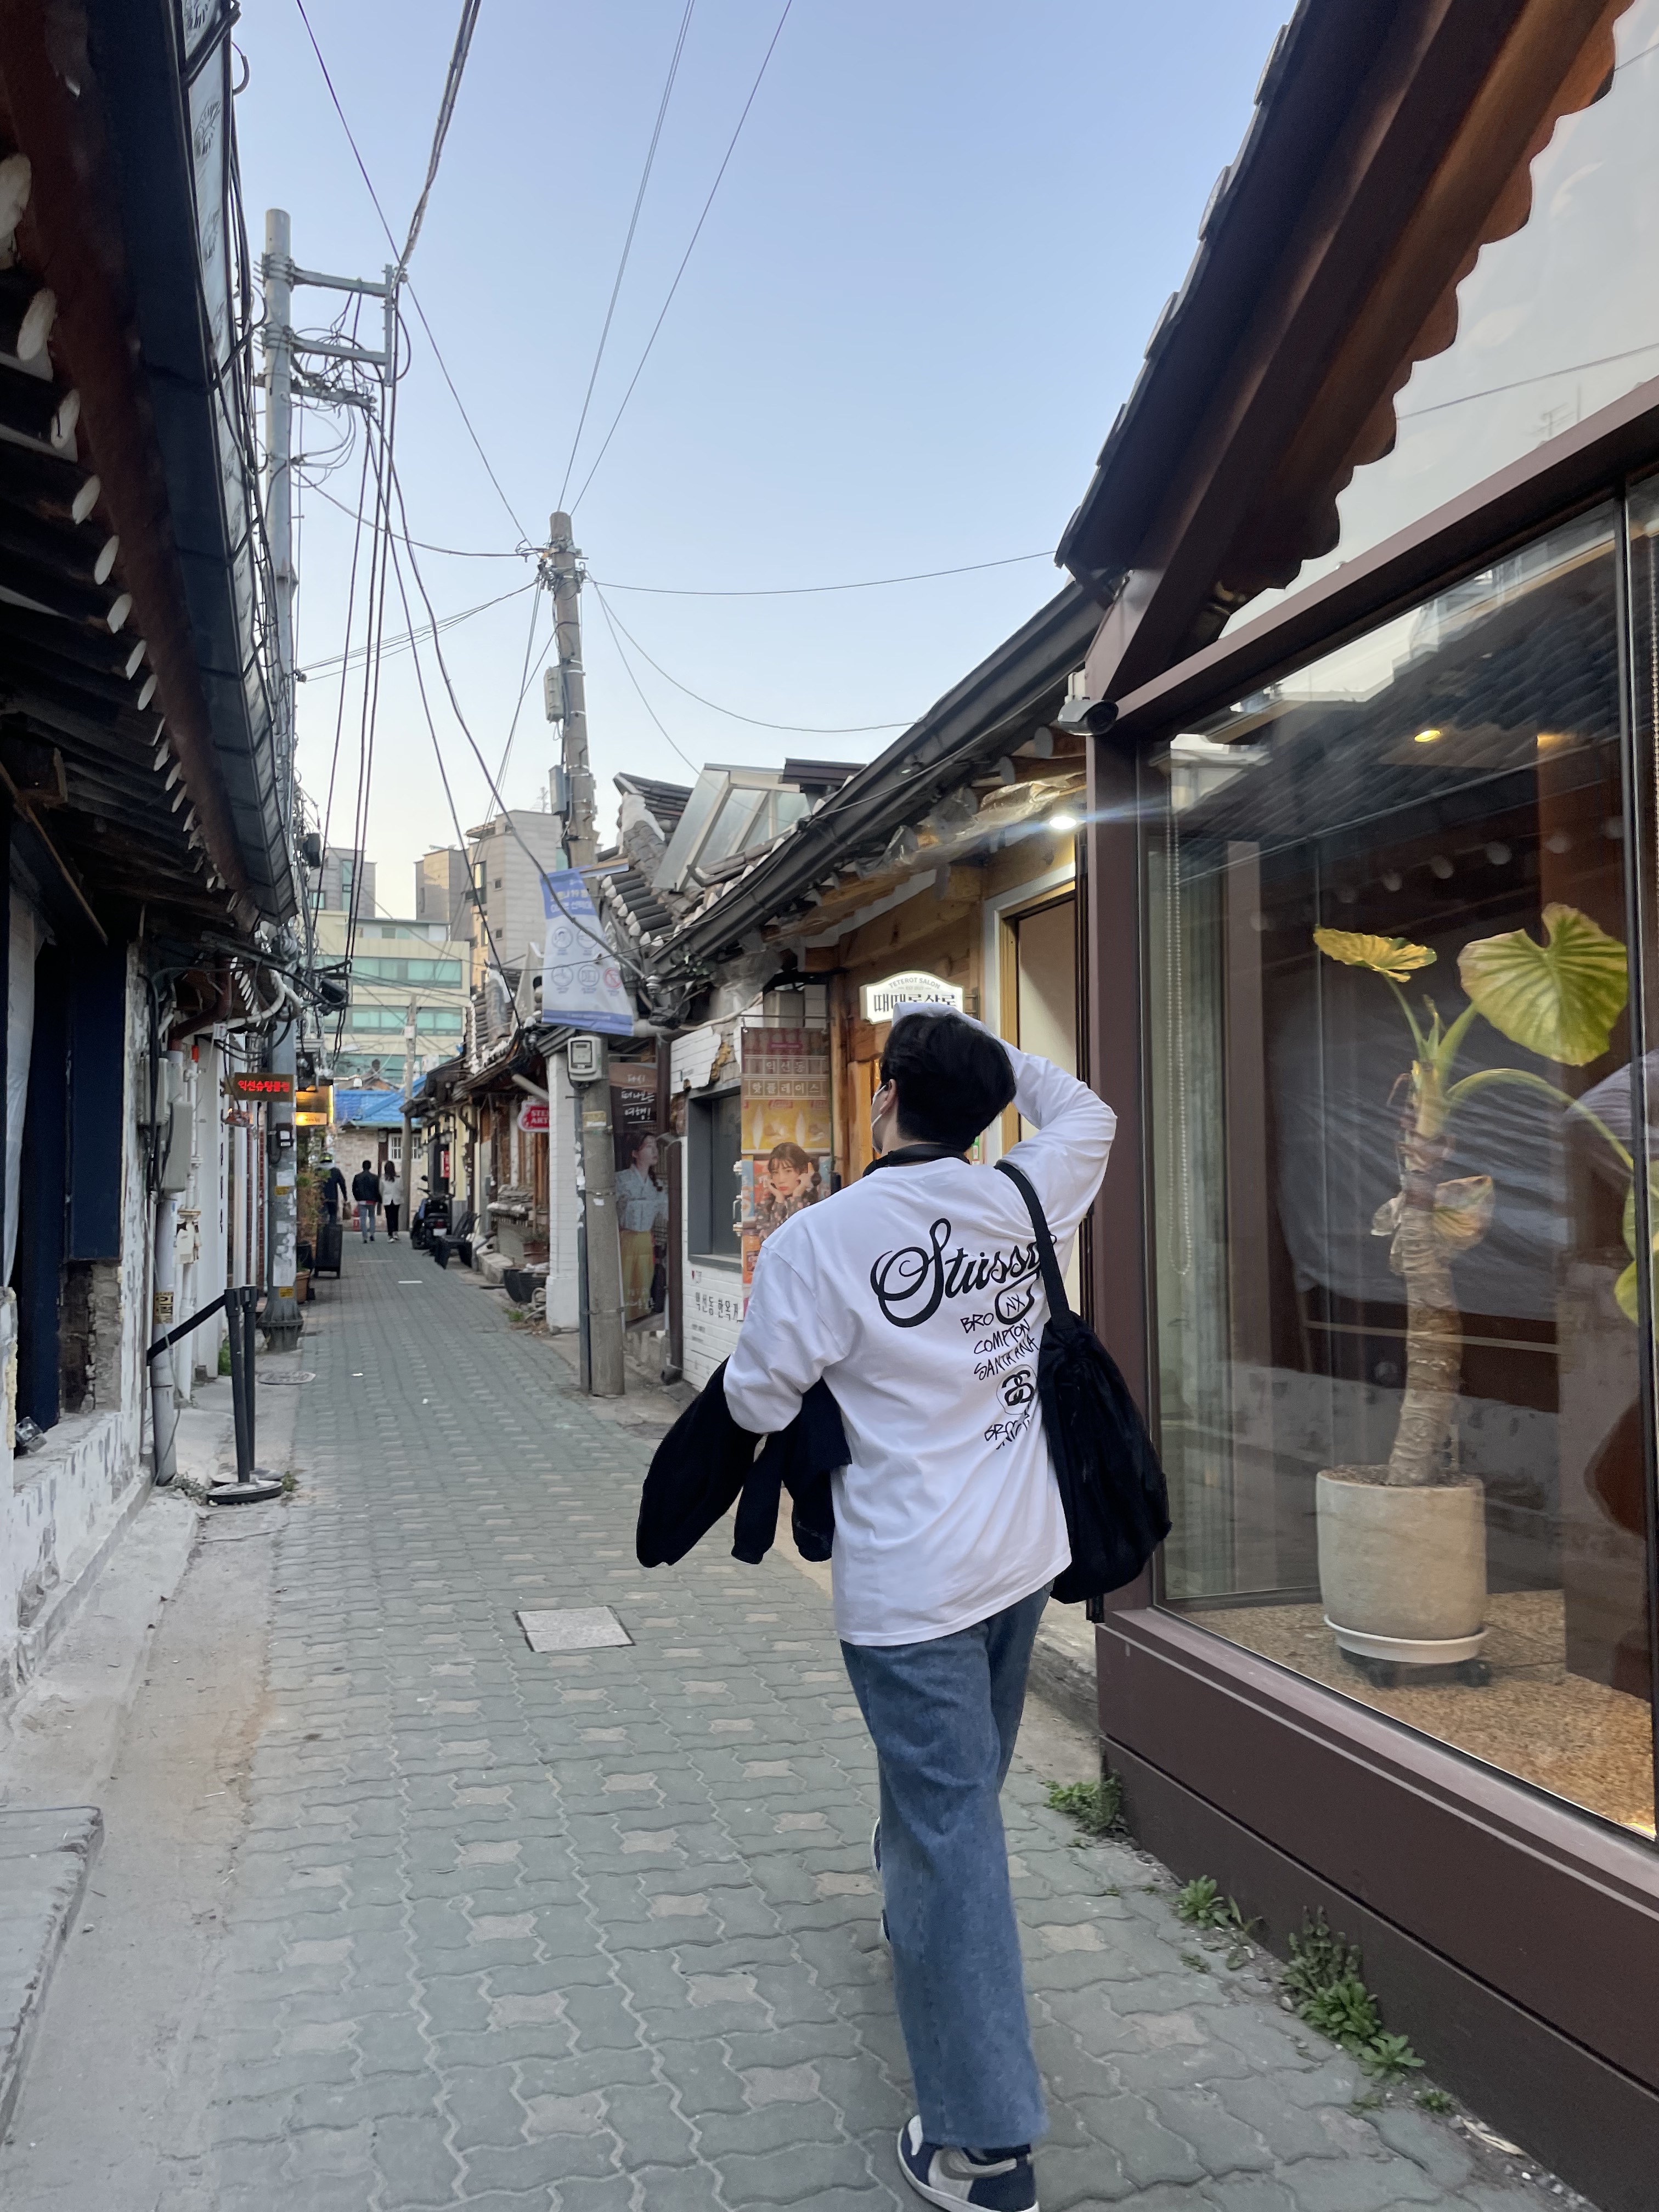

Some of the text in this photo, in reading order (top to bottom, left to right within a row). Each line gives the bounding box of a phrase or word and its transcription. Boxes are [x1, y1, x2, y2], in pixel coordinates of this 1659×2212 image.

[888, 977, 940, 989] TETEROT SALON
[766, 1060, 805, 1073] 익선동
[752, 1082, 821, 1094] 핫플레이스
[974, 1318, 1030, 1355] COMPTON
